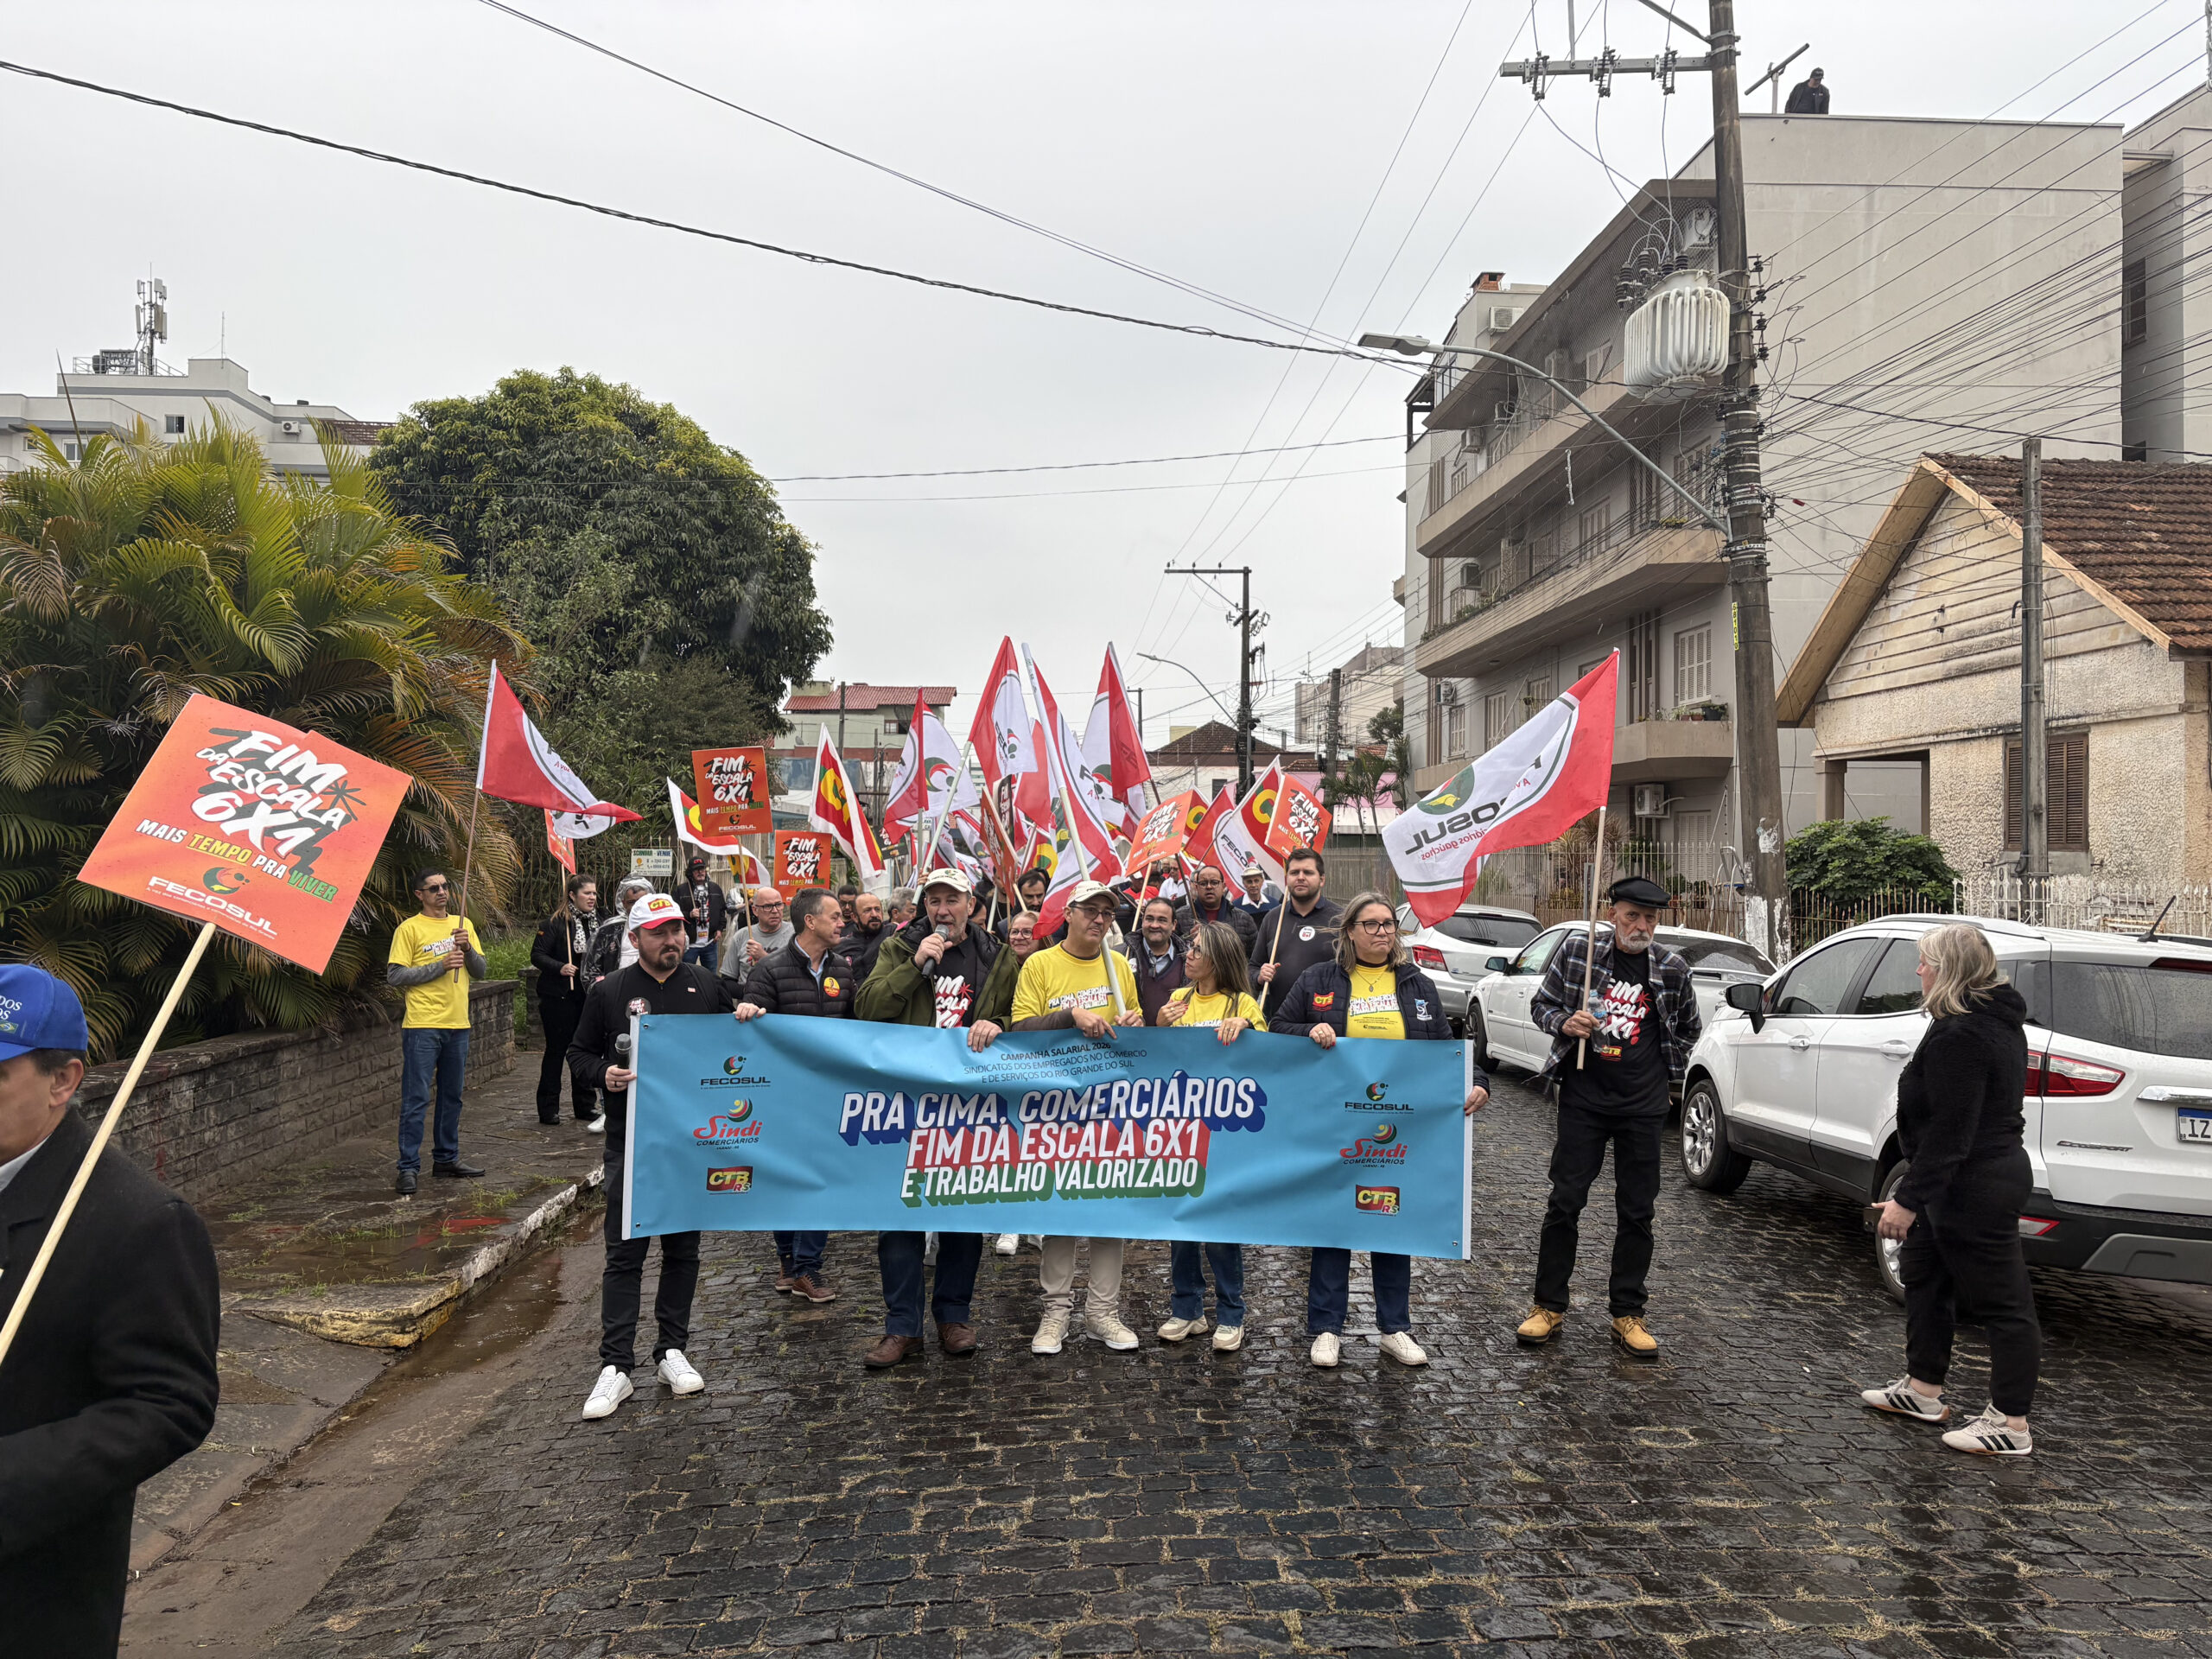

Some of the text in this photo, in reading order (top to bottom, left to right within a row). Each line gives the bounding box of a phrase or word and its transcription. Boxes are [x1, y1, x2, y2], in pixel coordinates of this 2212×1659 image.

[227, 730, 348, 795] FIM
[711, 755, 746, 772] FIM
[711, 772, 753, 785] ESCALA
[195, 747, 348, 831] DA ESCALA
[714, 784, 748, 804] 6X1
[706, 806, 719, 815] MAIS
[1295, 791, 1319, 819] FIM
[191, 791, 316, 860] 6X1
[1288, 816, 1314, 843] 6X1
[789, 837, 817, 853] FIM
[136, 819, 339, 903] MAIS TEMPO PRA VIVER
[788, 851, 821, 862] ESCALA
[787, 861, 816, 879] 6X1
[148, 876, 277, 936] FECOSUL
[650, 899, 672, 910] CTB
[936, 996, 969, 1010] CALA
[1314, 995, 1333, 1005] CTB
[1001, 1041, 1111, 1061] CAMPANHA SALARIAL 2026
[963, 1064, 1014, 1075] SINDICATOS
[1014, 1062, 1032, 1071] DOS
[1033, 1055, 1089, 1070] EMPREGADOS
[1090, 1052, 1103, 1061] NO
[982, 1075, 987, 1084] E
[988, 1074, 1000, 1084] DE
[1001, 1071, 1039, 1083] SERVIÇOS
[1055, 1068, 1069, 1077] RIO
[1070, 1063, 1104, 1076] GRANDE
[1105, 1061, 1118, 1070] DO
[1119, 1059, 1135, 1068] SUL
[701, 1077, 772, 1086] FECOSUL
[838, 1070, 1257, 1134] PRA CIMA, COMERCIÁRIOS
[1344, 1101, 1414, 1111] FECOSUL
[693, 1116, 764, 1140] Sindi
[696, 1136, 760, 1147] COMERCIÁRIOS
[906, 1118, 1201, 1166] FIM DA ESCALA 6X1
[1339, 1138, 1408, 1159] Sindi
[1343, 1157, 1406, 1166] COMERCIÁRIOS
[709, 1171, 750, 1186] CTB
[900, 1157, 1199, 1198] E TRABALHO VALORIZADO
[733, 1182, 751, 1192] RS
[1357, 1189, 1397, 1207] CTB
[1382, 1205, 1399, 1214] RS
